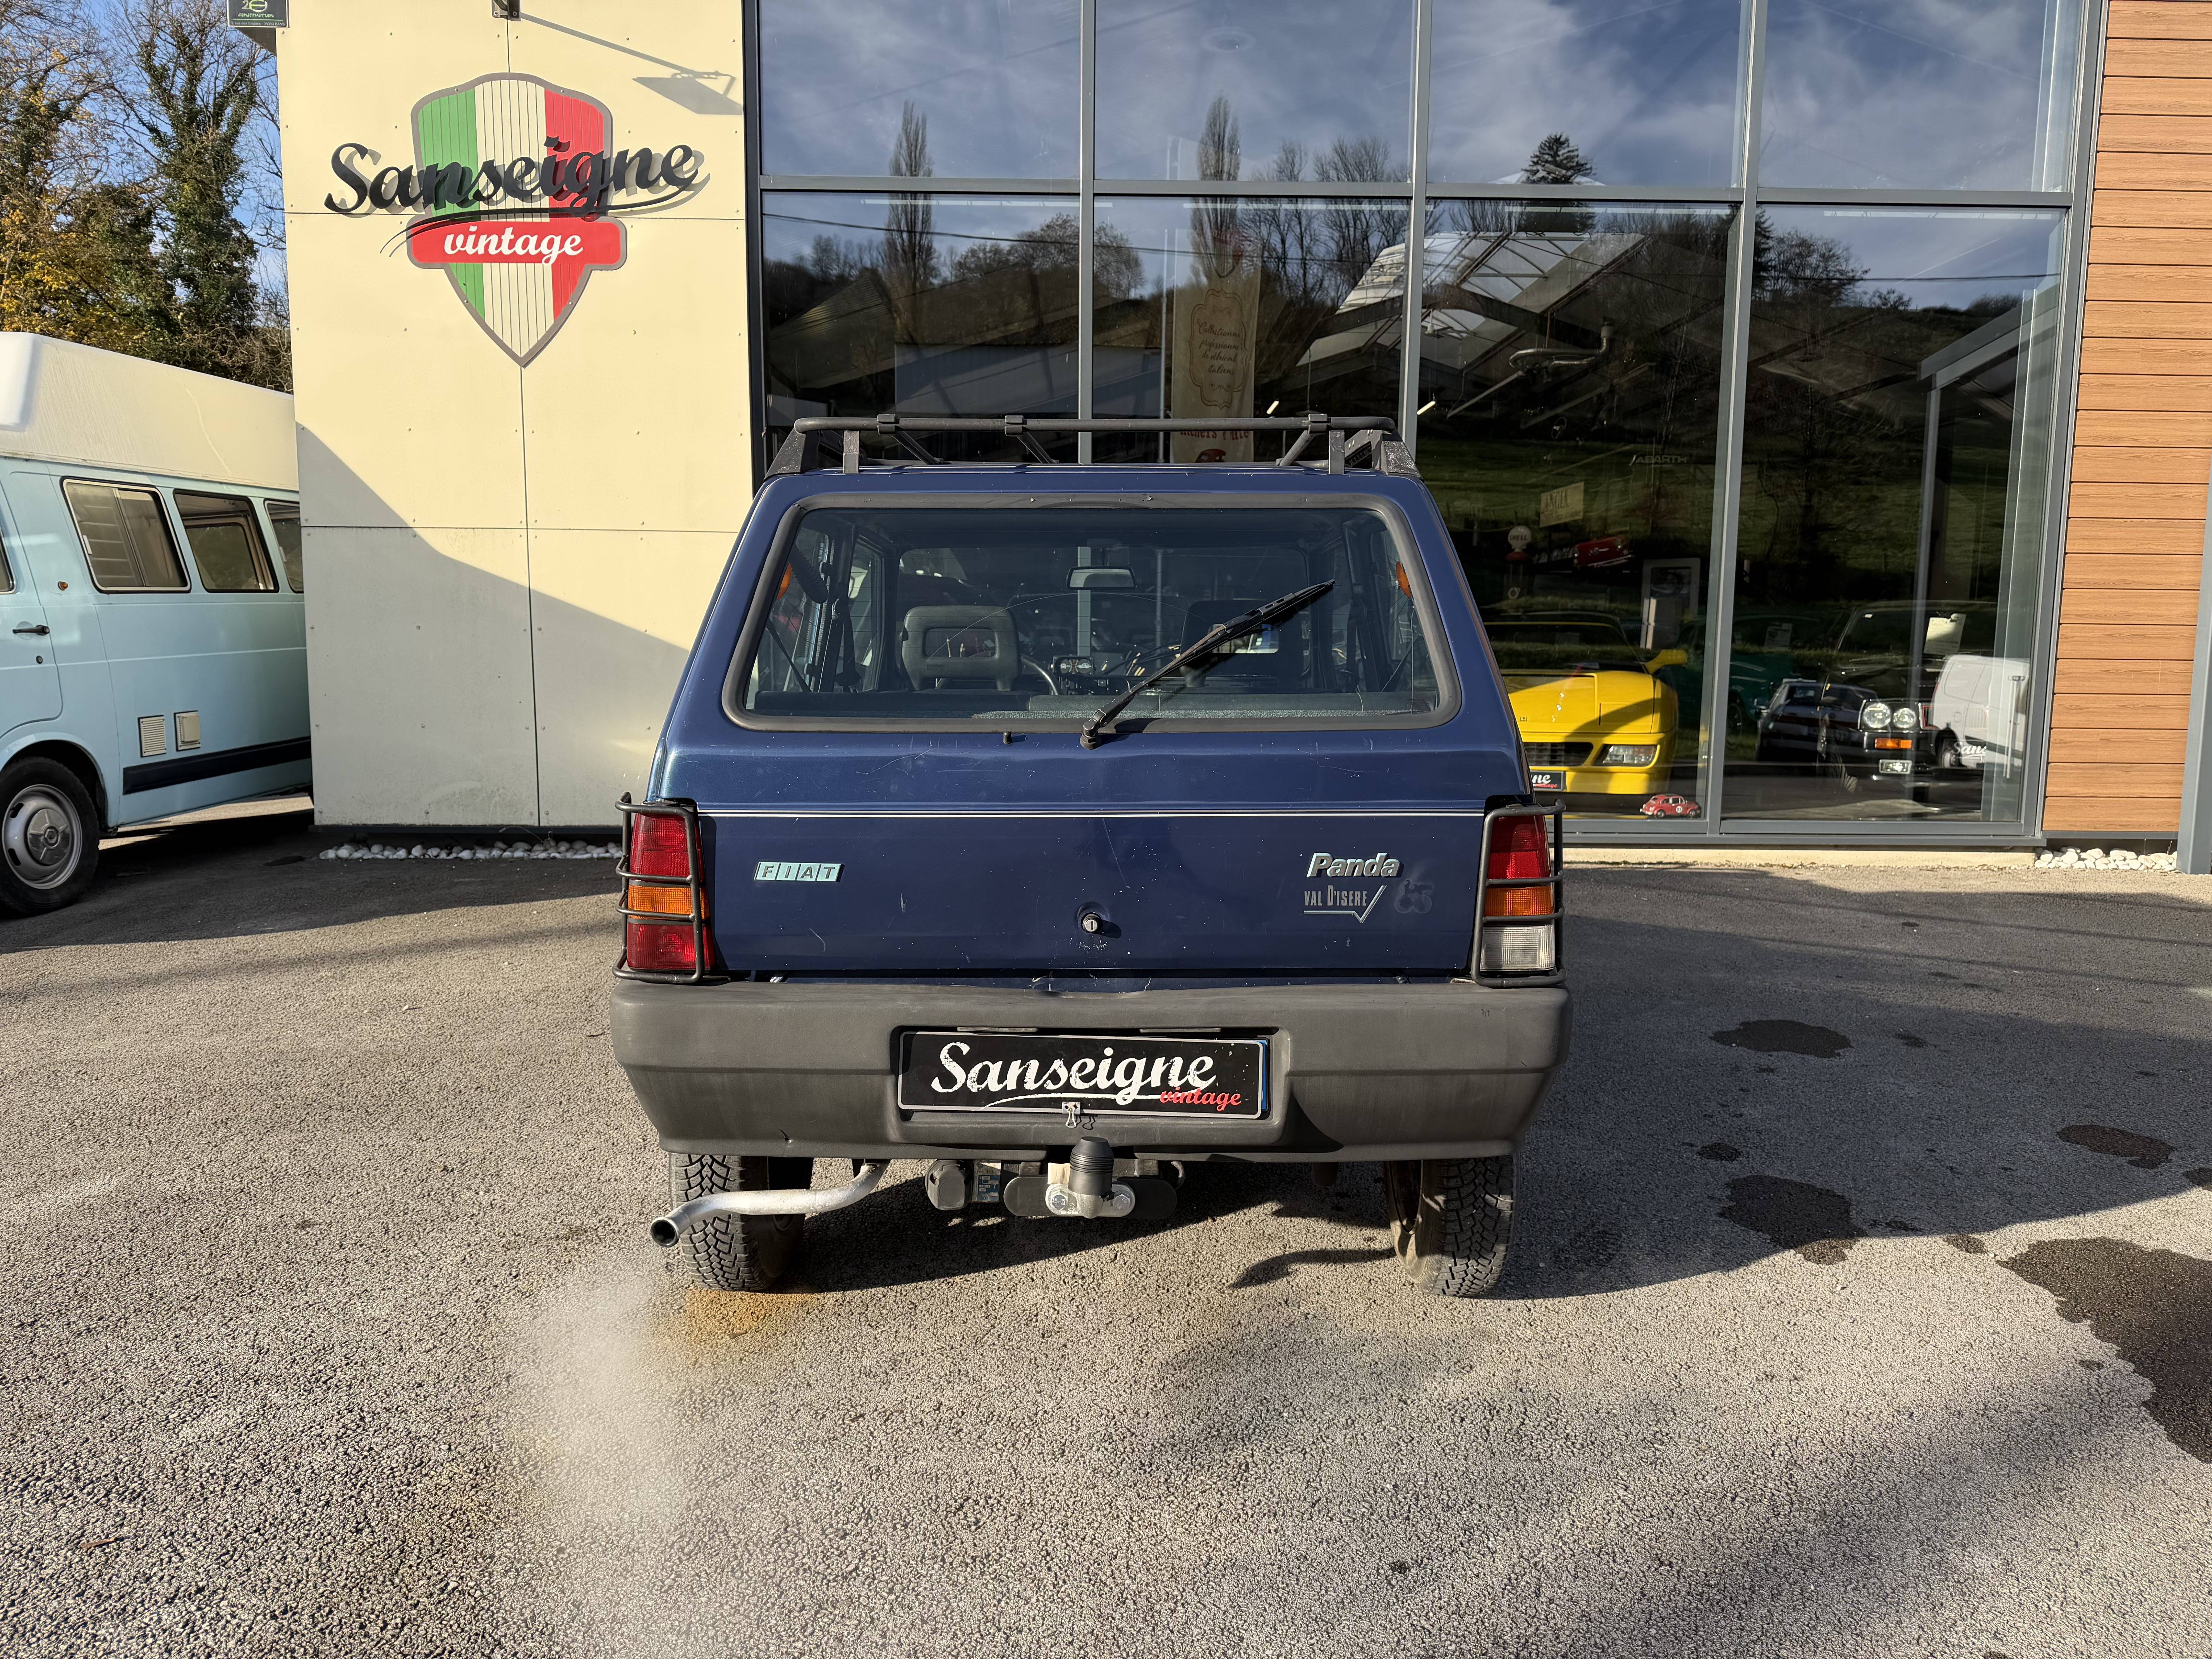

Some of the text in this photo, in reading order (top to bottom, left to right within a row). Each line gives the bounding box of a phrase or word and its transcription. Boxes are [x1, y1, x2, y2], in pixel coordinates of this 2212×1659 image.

[324, 136, 699, 215] Sanseigne
[443, 225, 584, 265] vintage
[1635, 455, 1686, 464] ABARTH
[759, 863, 838, 881] FIAT
[1307, 853, 1403, 878] Panda
[1304, 885, 1367, 906] VAL D'ISERE
[931, 1041, 1216, 1106] Sanseigne
[1159, 1088, 1242, 1111] vintage
